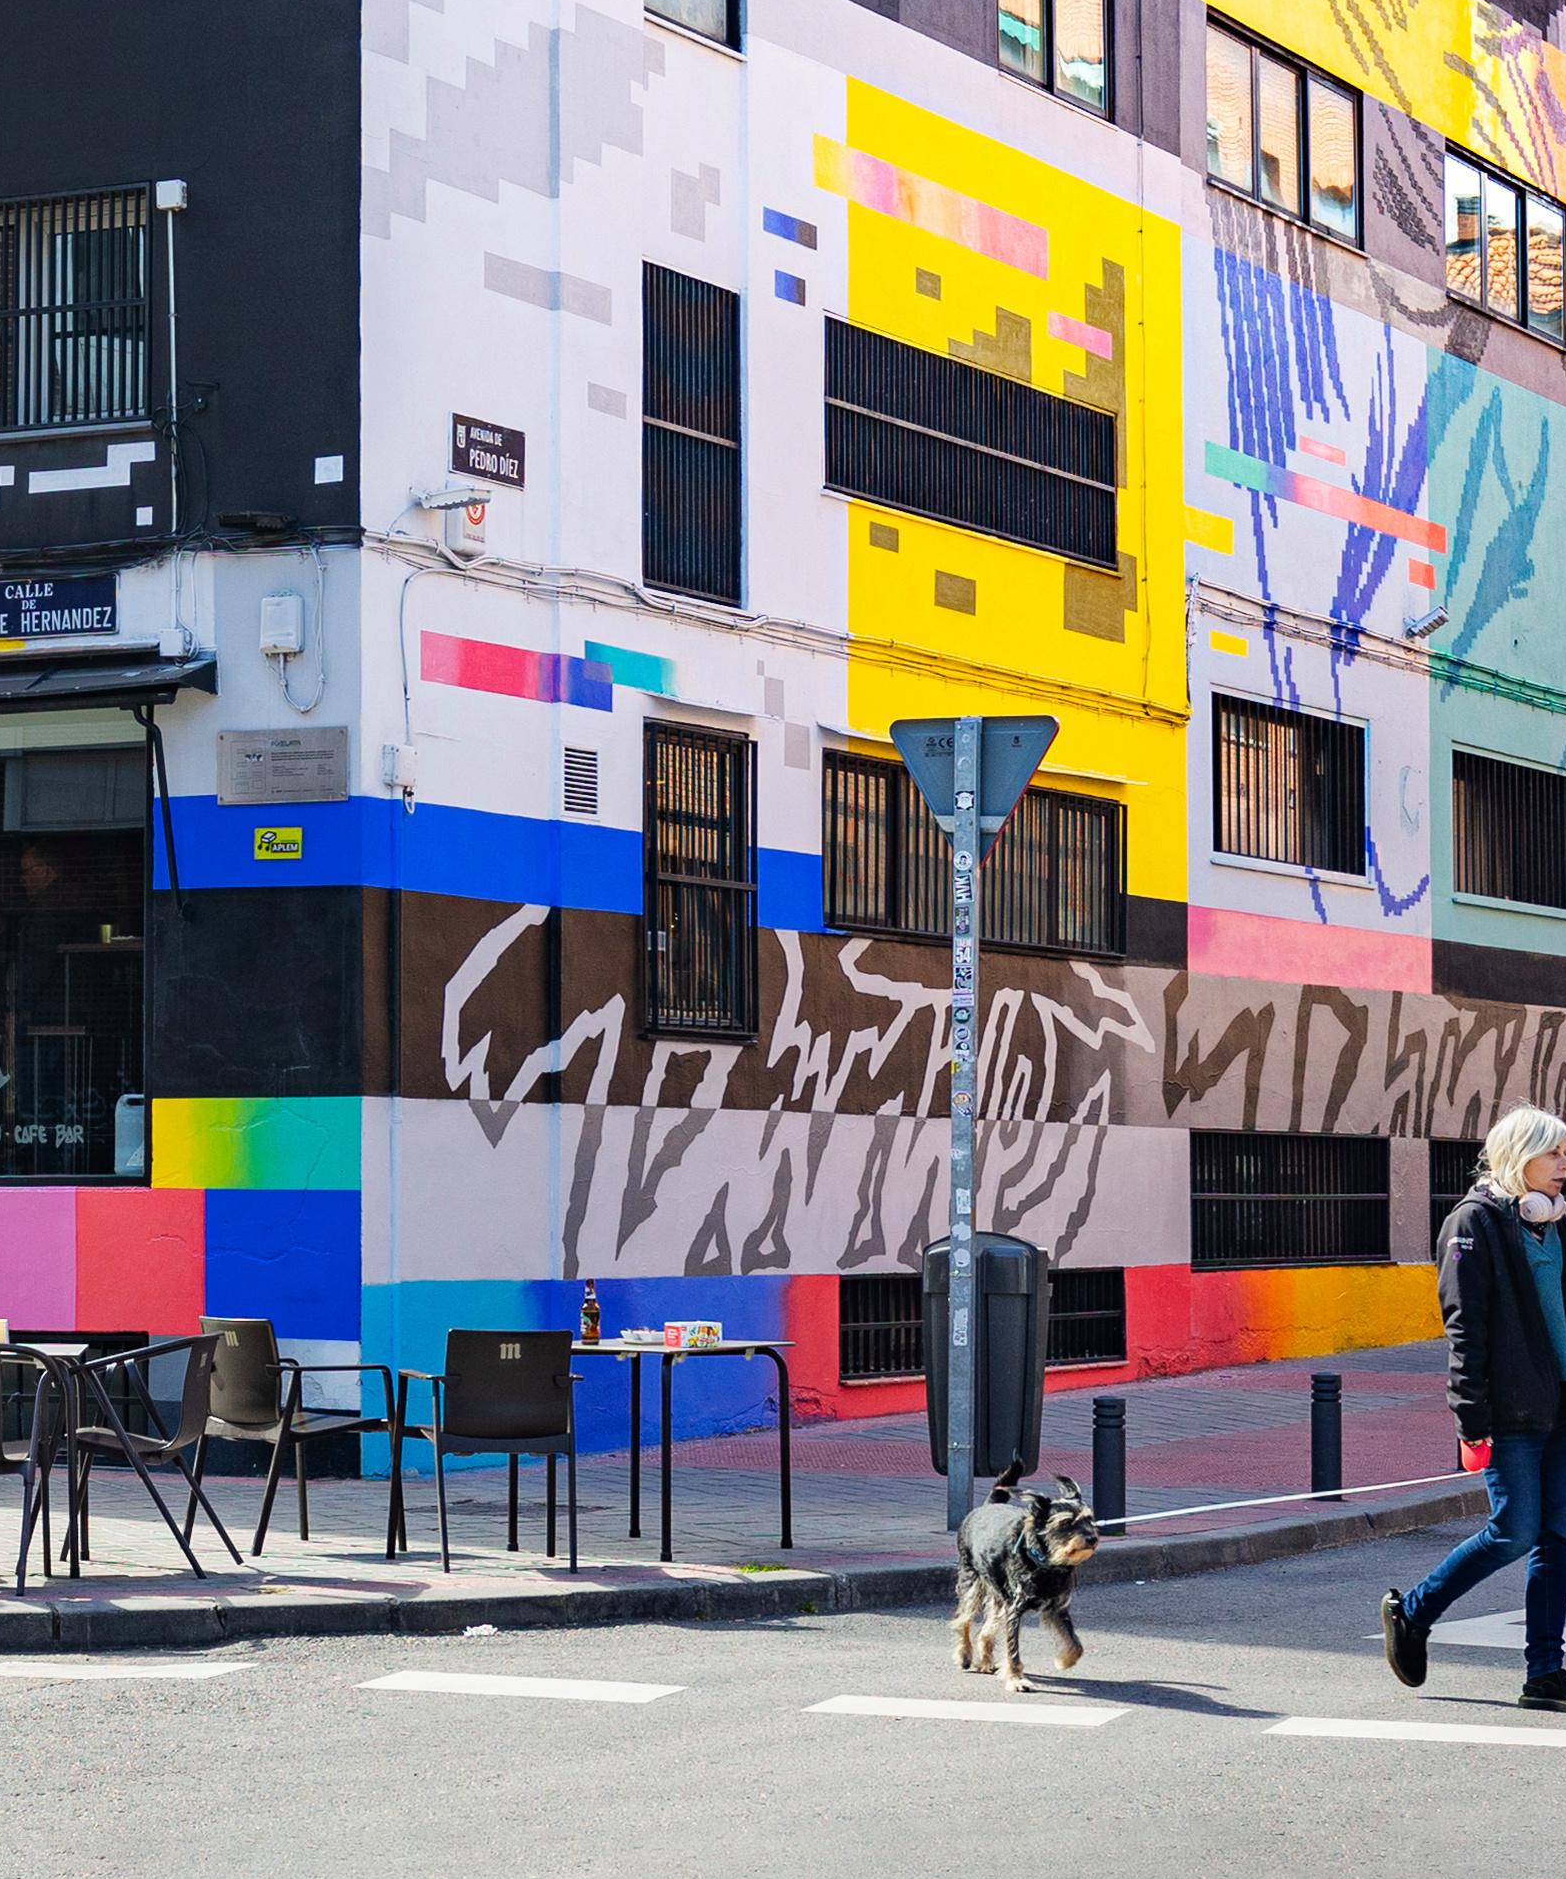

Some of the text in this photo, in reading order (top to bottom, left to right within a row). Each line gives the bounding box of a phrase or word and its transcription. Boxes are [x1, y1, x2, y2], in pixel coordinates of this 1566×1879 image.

[494, 432, 503, 447] DE
[469, 449, 519, 479] PEDRO DÍEZ
[5, 583, 54, 599] CALLE
[21, 599, 37, 610] DE
[21, 606, 112, 633] HERNANDEZ
[955, 947, 971, 963] 54
[54, 1124, 85, 1148] BAR
